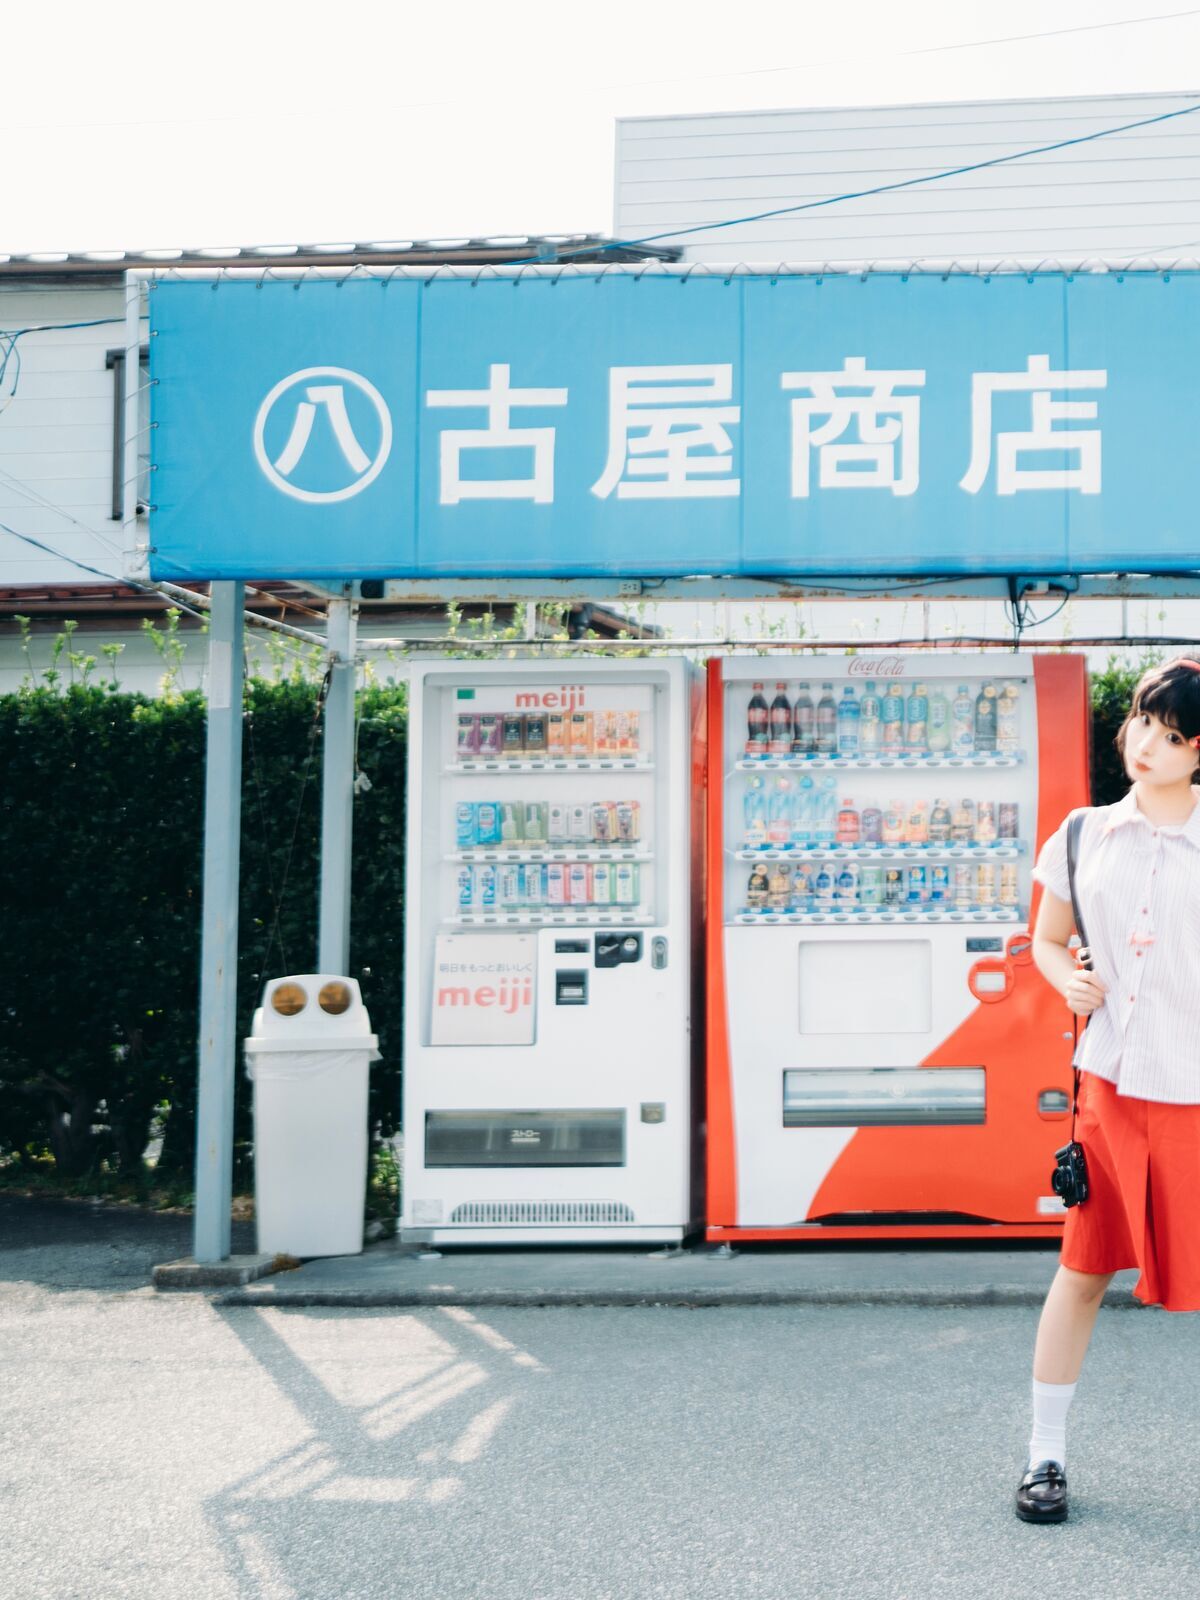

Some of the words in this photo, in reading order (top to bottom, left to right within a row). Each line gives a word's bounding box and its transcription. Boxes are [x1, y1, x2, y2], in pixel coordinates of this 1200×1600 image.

[426, 354, 1107, 504] 古屋商店
[848, 656, 904, 675] Coca-Cola
[515, 686, 585, 713] meiji
[438, 976, 532, 1014] meiji
